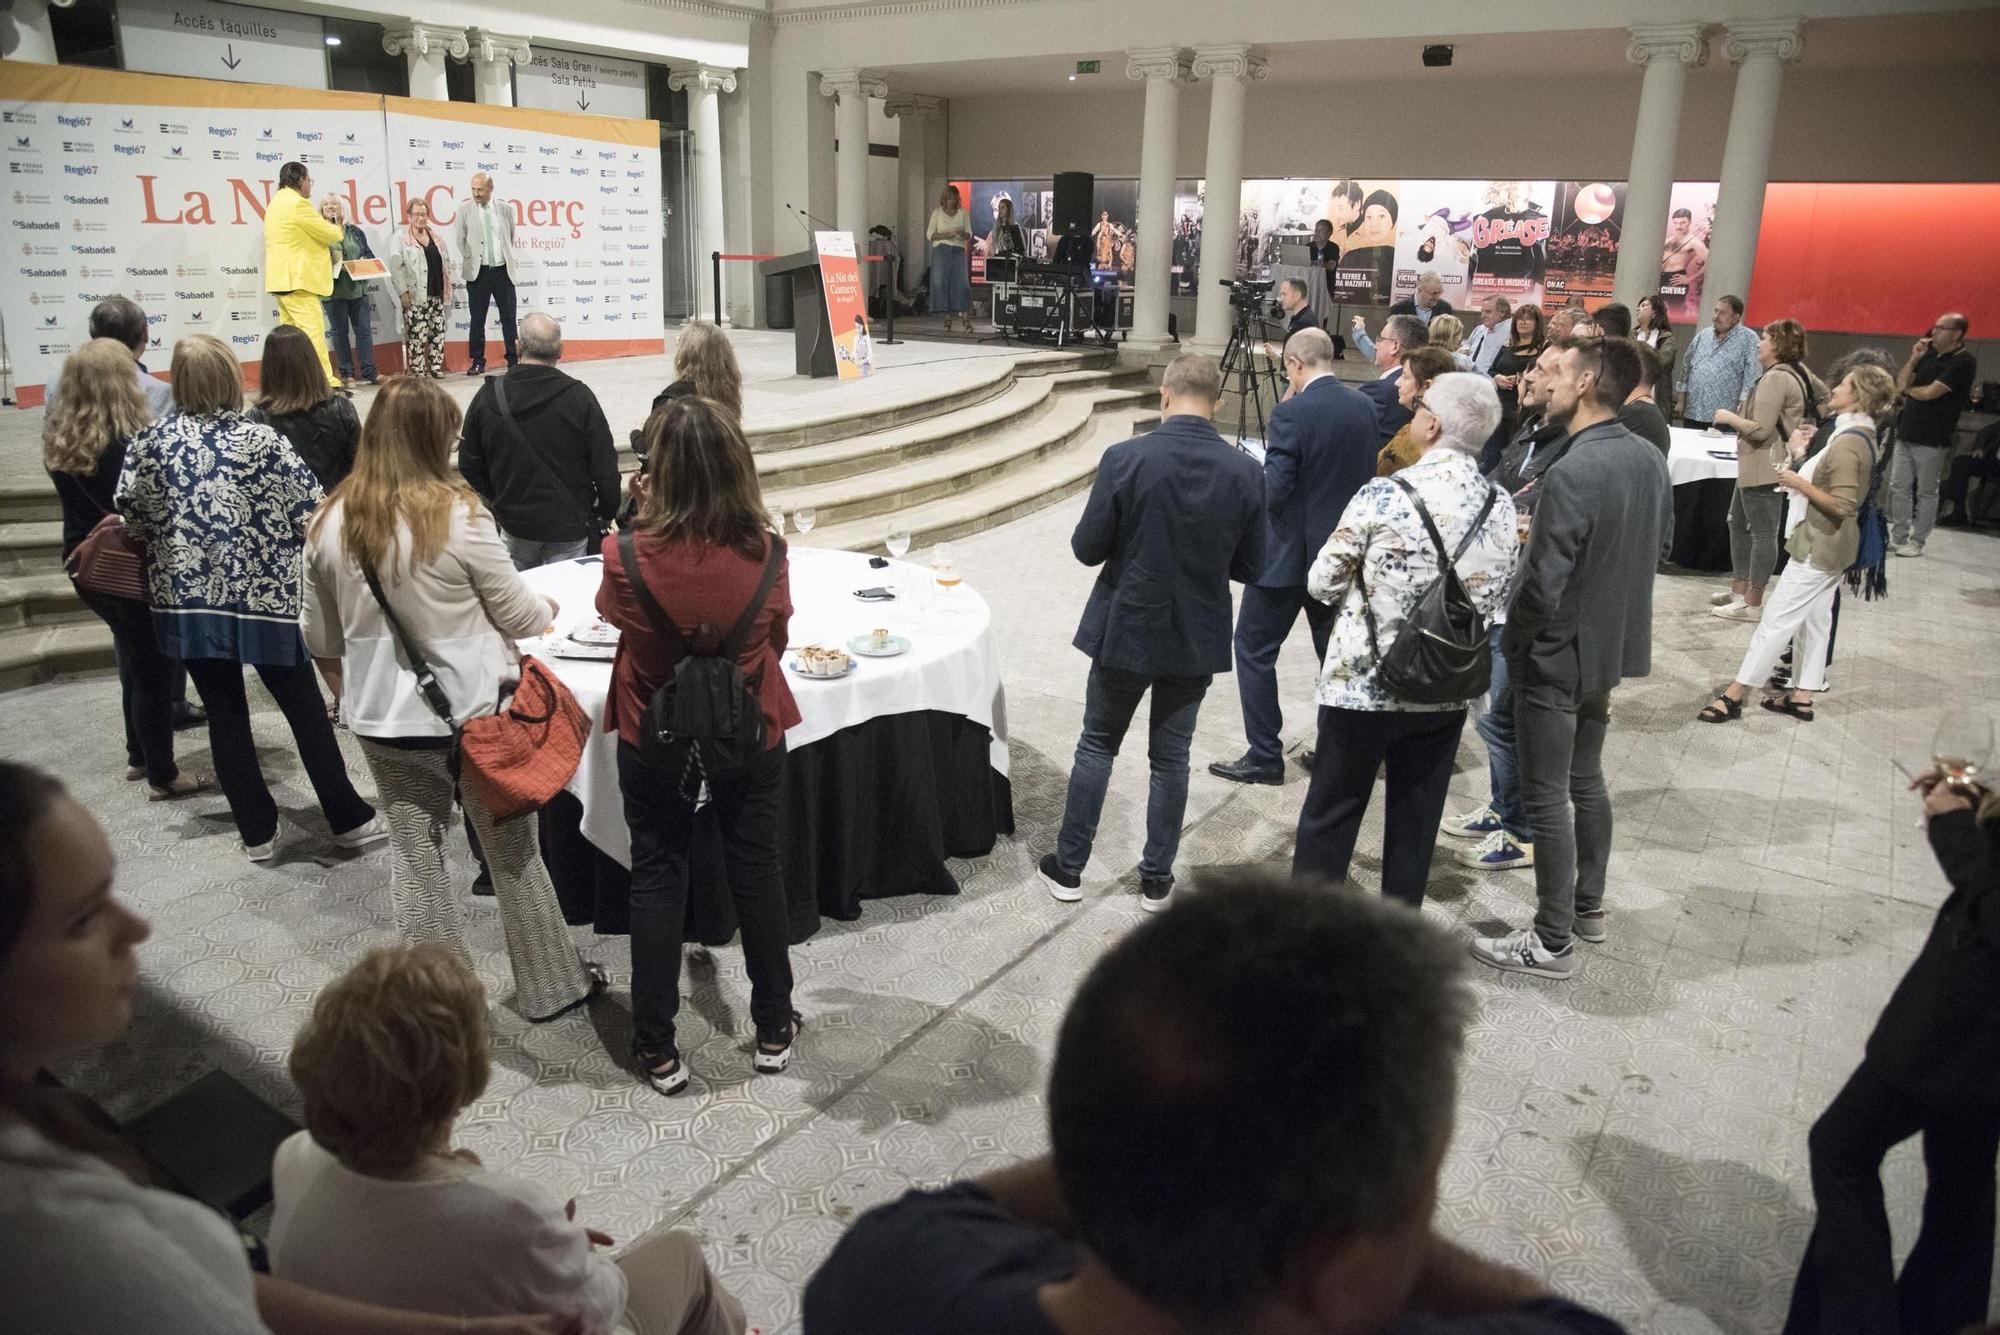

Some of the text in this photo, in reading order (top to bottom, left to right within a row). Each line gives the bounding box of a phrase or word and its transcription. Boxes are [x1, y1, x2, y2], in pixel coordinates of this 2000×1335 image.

[174, 12, 278, 39] Accés taquilles
[551, 57, 570, 70] Sala
[572, 60, 592, 73] Gran
[551, 73, 597, 89] Sala Petita
[57, 115, 93, 128] Regió7
[208, 126, 238, 138] Regió7
[296, 131, 323, 142] Regió7
[114, 144, 146, 156] Regió7
[442, 140, 464, 150] Regió7
[539, 146, 559, 155] Regió7
[255, 152, 283, 162] Regió7
[339, 155, 365, 165] Regió7
[64, 164, 98, 176] Regió7
[477, 162, 499, 171] Regió7
[69, 195, 109, 205] Sabadell
[135, 175, 217, 226] La
[423, 184, 585, 240] Cerç
[19, 220, 61, 231] Sabadell
[1473, 215, 1549, 249] GREASE
[78, 245, 116, 255] Sabadell
[514, 237, 567, 252] de Regió7
[26, 269, 67, 278] Sabadell
[131, 267, 168, 277] Sabadell
[225, 266, 258, 275] Sabadell
[825, 271, 858, 284] La Nit del
[180, 290, 214, 300] Sabadell
[829, 284, 857, 296] Comerç
[1660, 286, 1687, 295] CUEVAS
[232, 334, 260, 345] Regió7
